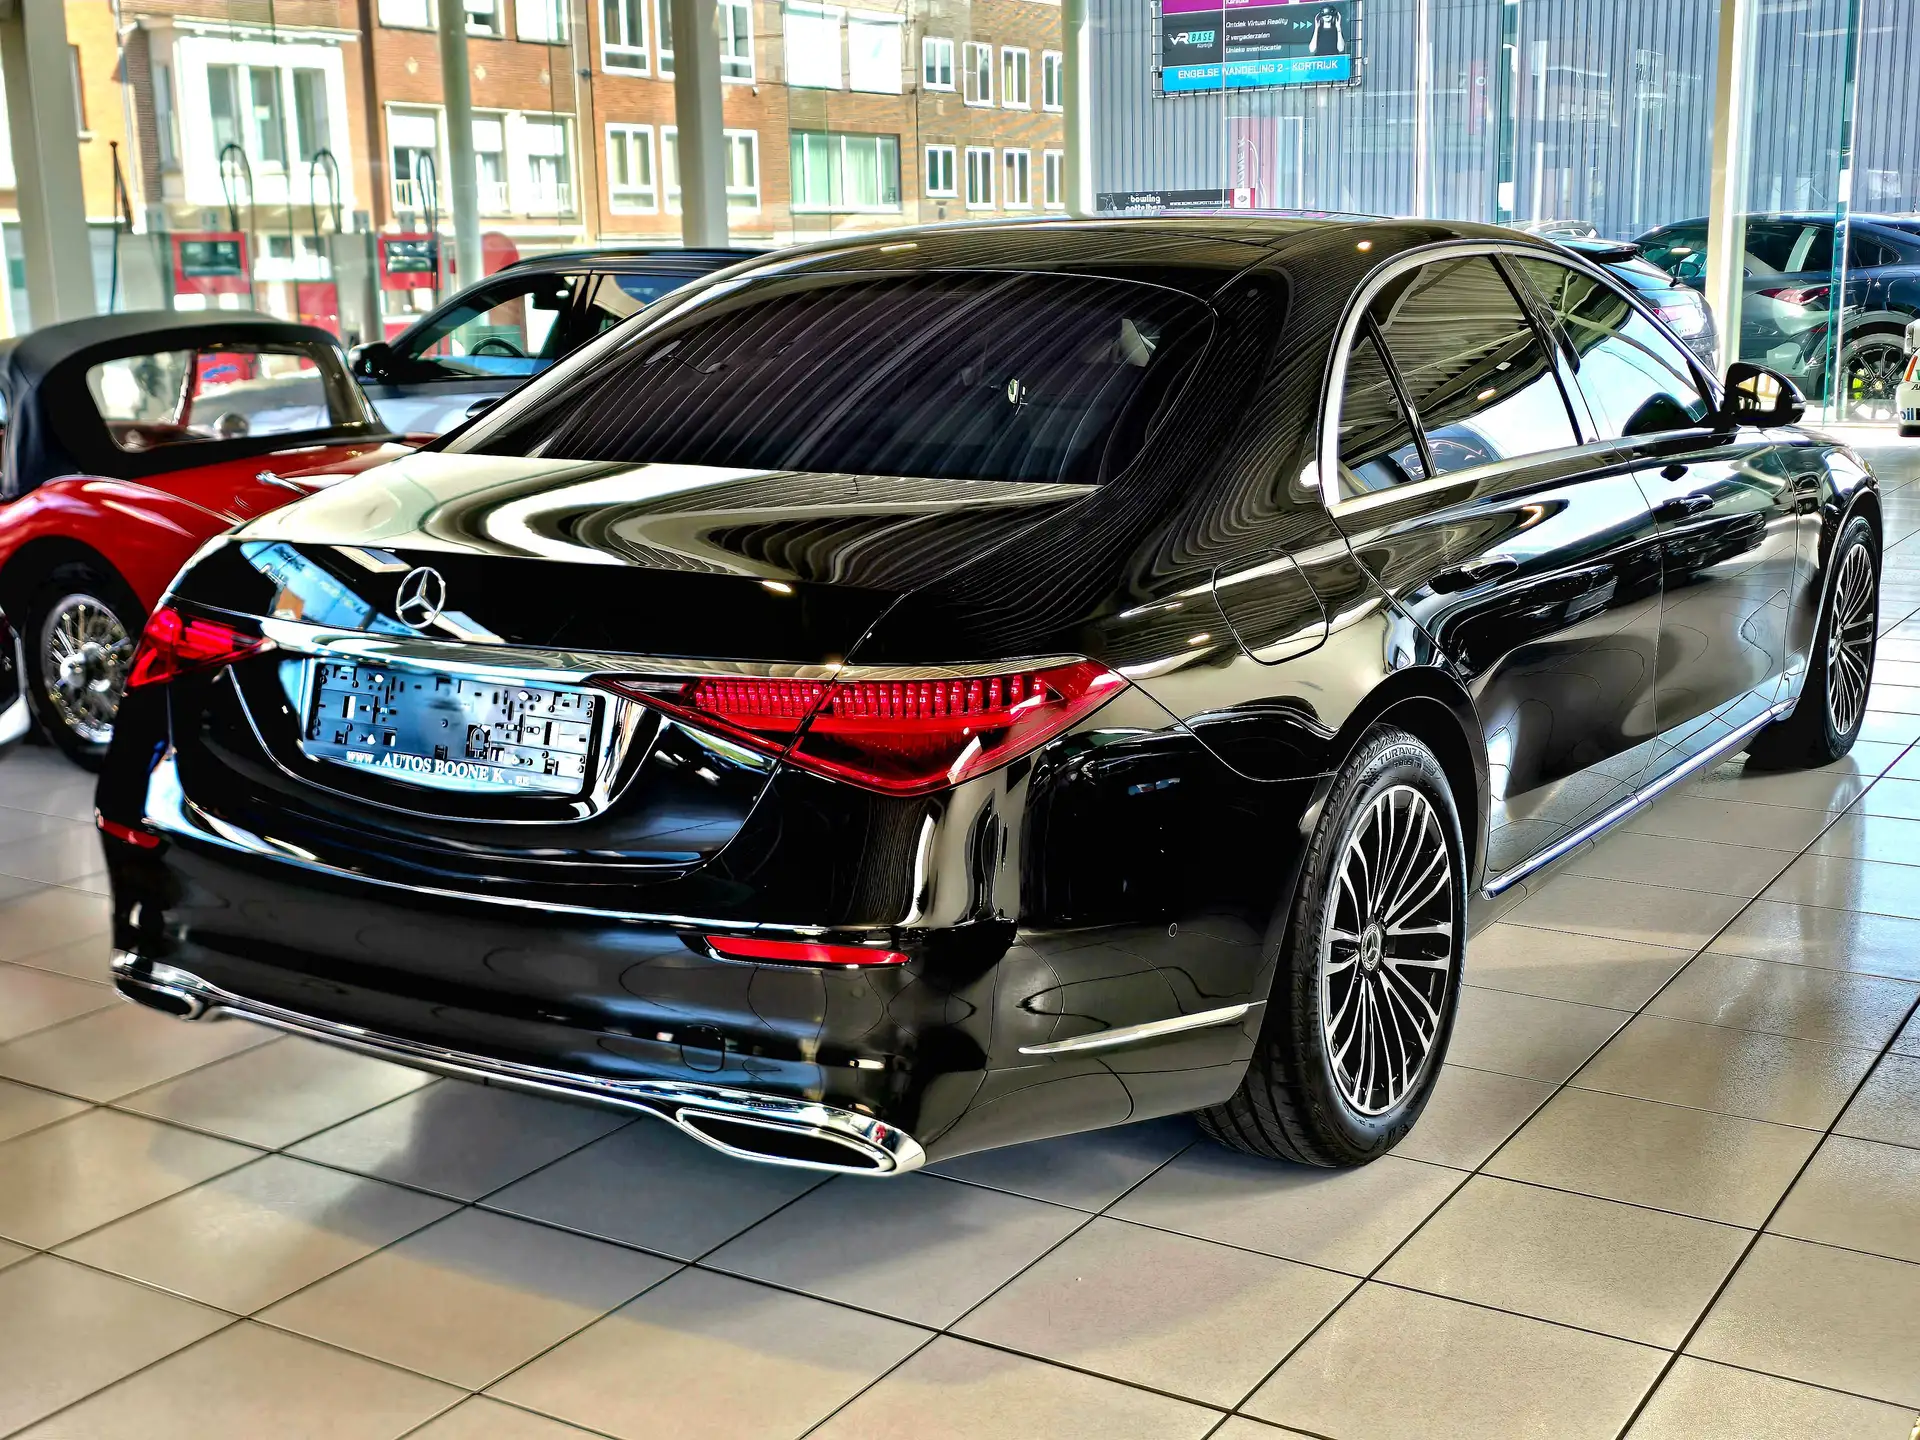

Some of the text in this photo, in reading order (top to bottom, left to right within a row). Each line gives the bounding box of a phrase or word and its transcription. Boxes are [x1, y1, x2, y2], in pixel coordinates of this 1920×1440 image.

[1247, 19, 1267, 27] Virtual
[1267, 17, 1288, 26] Reality
[1191, 32, 1213, 42] BASE
[1178, 68, 1219, 79] ENGELSE
[1222, 64, 1275, 76] WANDELING
[1277, 63, 1284, 73] 2
[1292, 60, 1338, 71] KORTRIJK
[1130, 194, 1161, 204] bowling
[1378, 747, 1424, 764] TURANZA
[434, 758, 488, 780] BOONE
